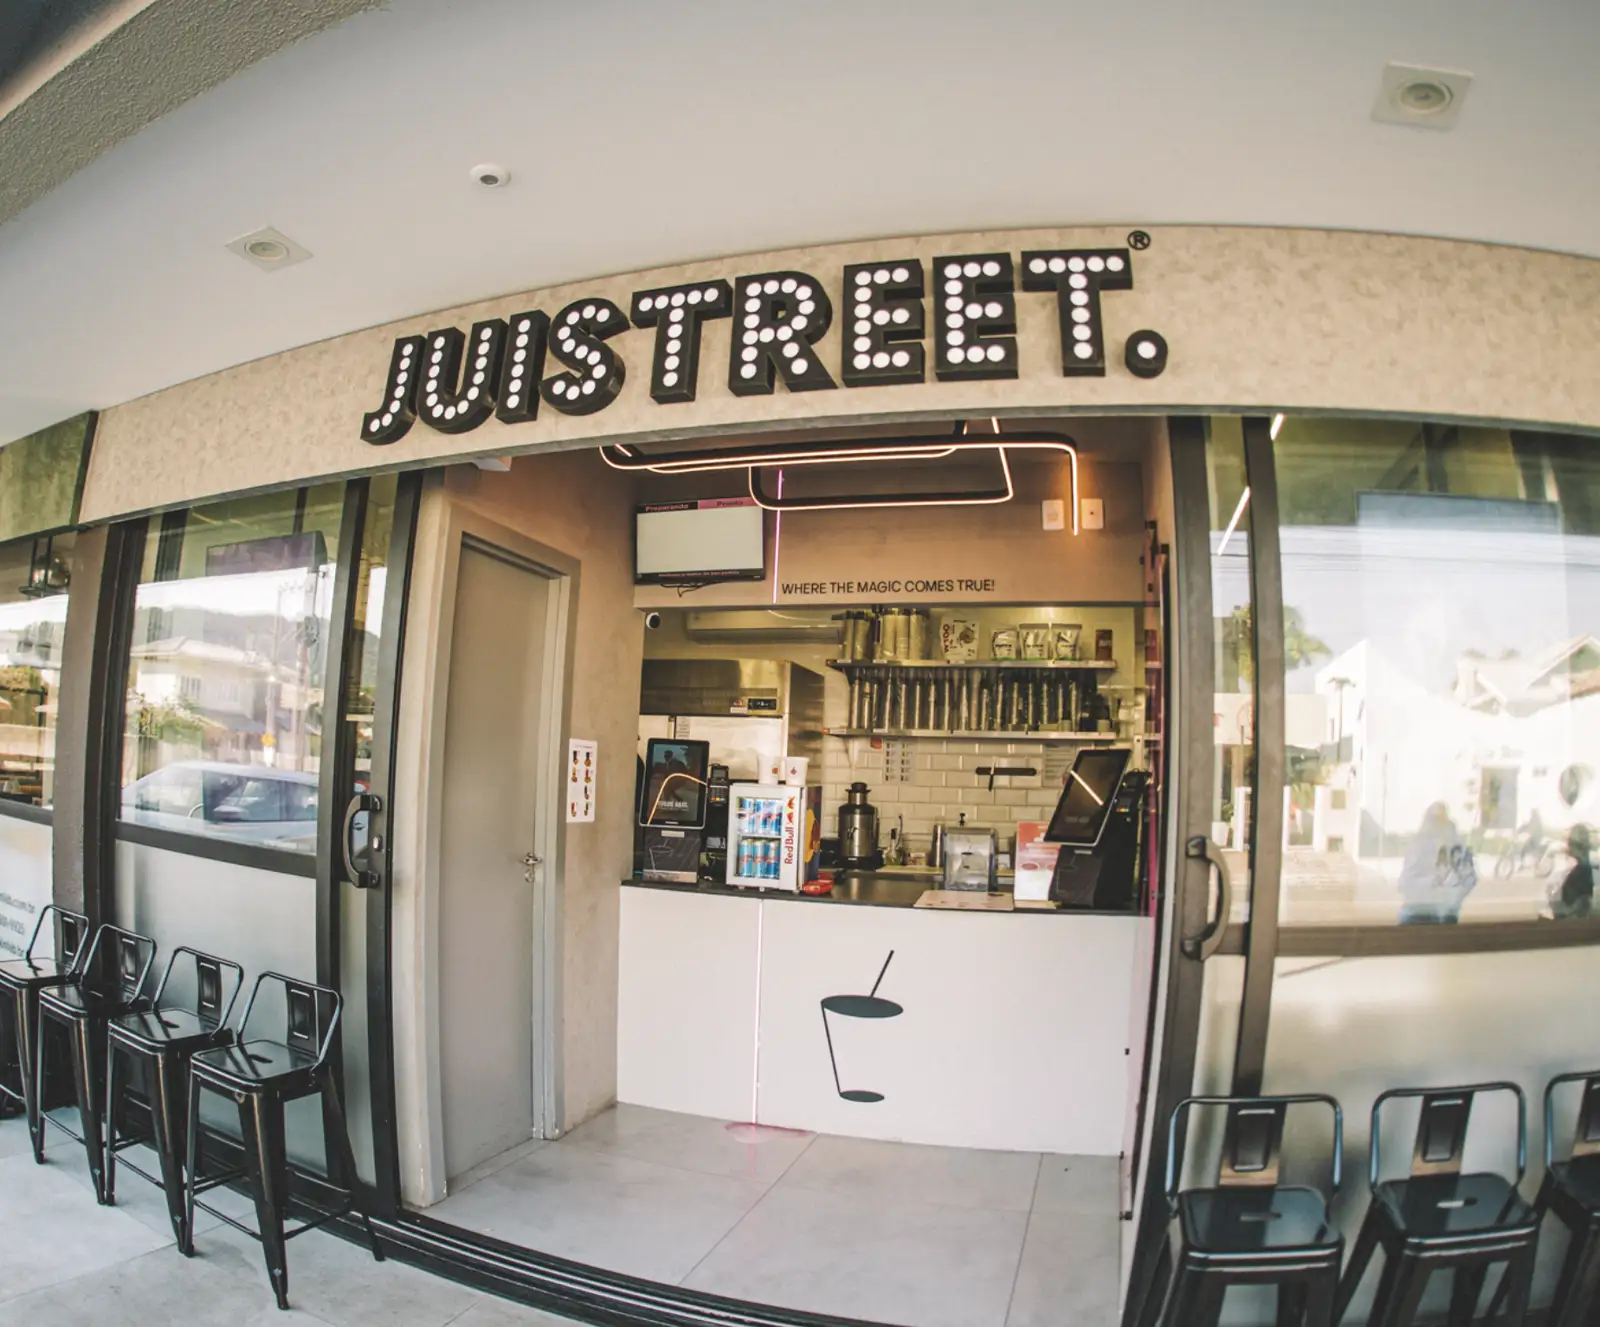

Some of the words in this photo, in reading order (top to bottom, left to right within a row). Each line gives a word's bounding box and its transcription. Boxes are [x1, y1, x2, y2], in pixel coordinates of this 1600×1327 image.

[781, 583, 826, 595] WHERE
[830, 582, 854, 594] THE
[857, 581, 902, 593] MAGIC
[904, 580, 954, 592] COMES
[957, 579, 995, 592] TRUE!
[785, 827, 794, 845] Bull
[784, 845, 793, 865] Red
